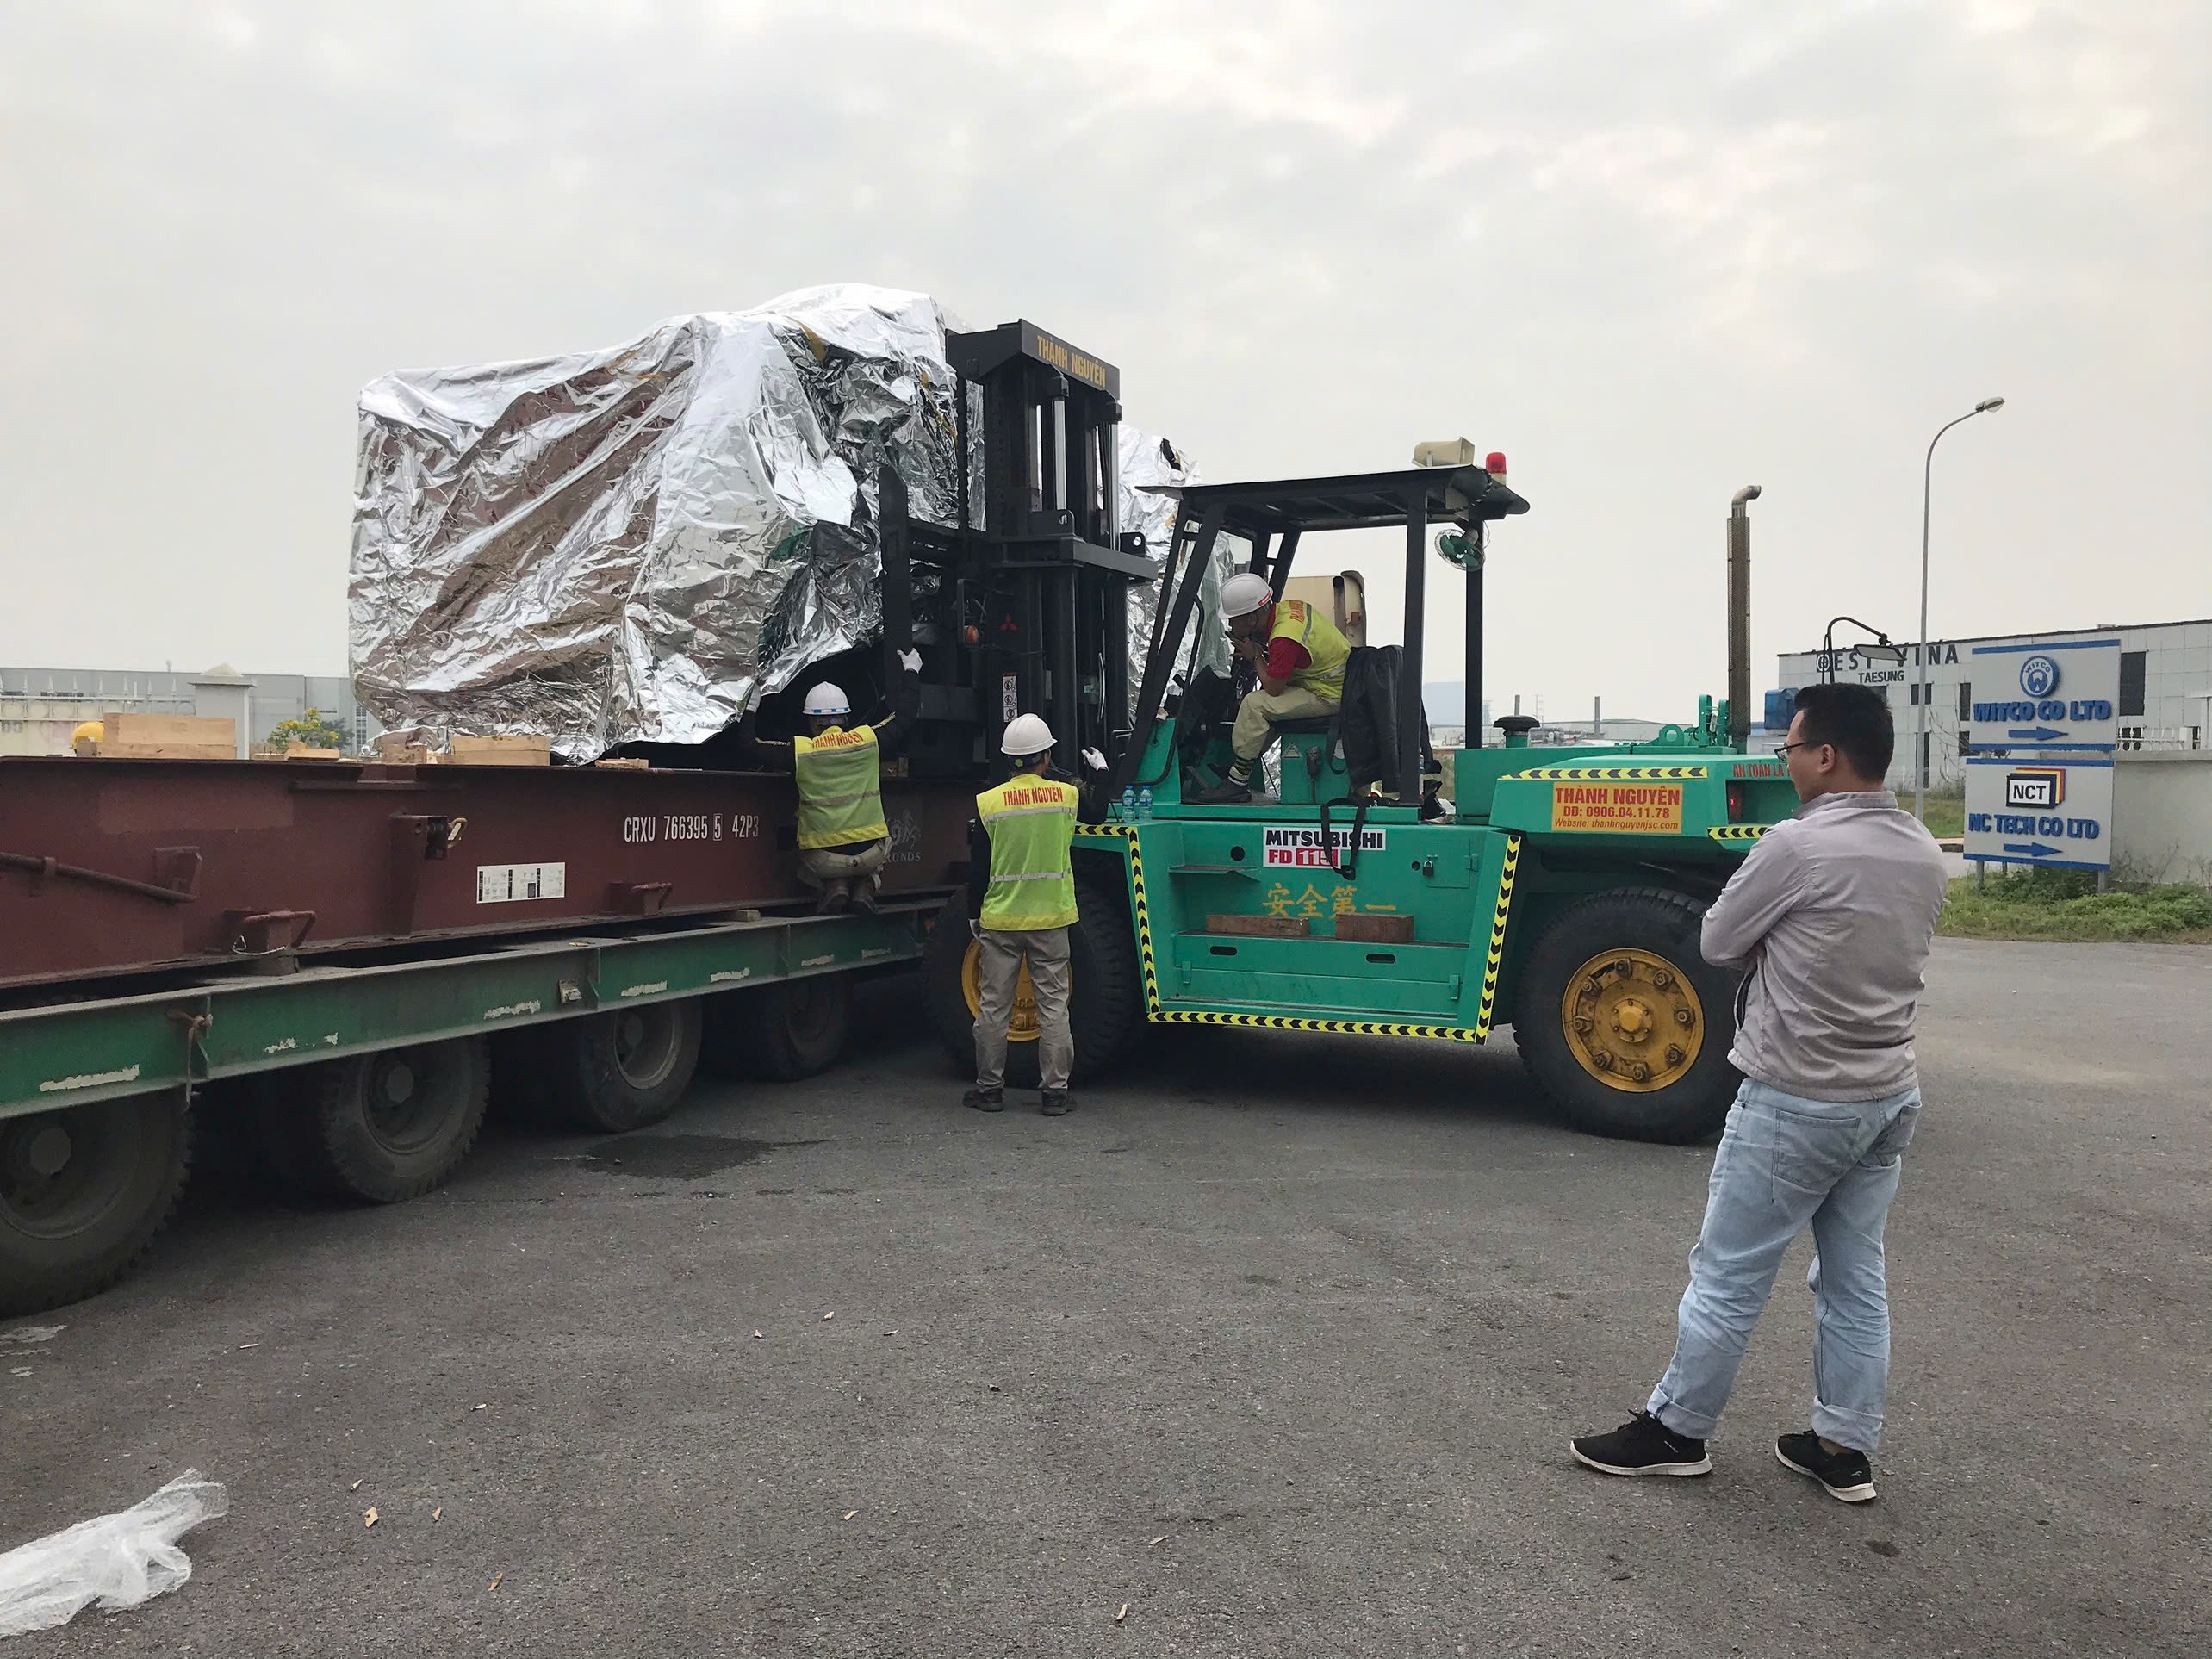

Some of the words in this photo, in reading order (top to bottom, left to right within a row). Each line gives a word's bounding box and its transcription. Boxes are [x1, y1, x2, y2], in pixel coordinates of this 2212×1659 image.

[2025, 661, 2051, 674] WITCO
[1858, 670, 1904, 683] TAESUNG
[1973, 700, 2035, 722] WITCO
[2037, 700, 2066, 721] CO
[2070, 699, 2111, 721] LTD
[1555, 785, 1608, 804] THÀNH
[1613, 786, 1680, 805] NGUYÊN
[2013, 785, 2047, 800] NCT
[1586, 806, 1670, 818] 0906.04.11.78
[624, 817, 656, 842] CRXU
[663, 815, 708, 841] 766395
[731, 814, 759, 838] 42P3
[1555, 817, 1589, 828] Website:
[1591, 819, 1679, 831] thanhnguyenjsc.com
[1968, 812, 1992, 832] NC
[1994, 814, 2035, 835] TECH
[2038, 816, 2064, 837] CO
[2066, 817, 2100, 839] LTD
[1265, 830, 1383, 848] MITSUBISHI
[1268, 849, 1293, 864] FD
[1262, 882, 1397, 919] 安全第一
